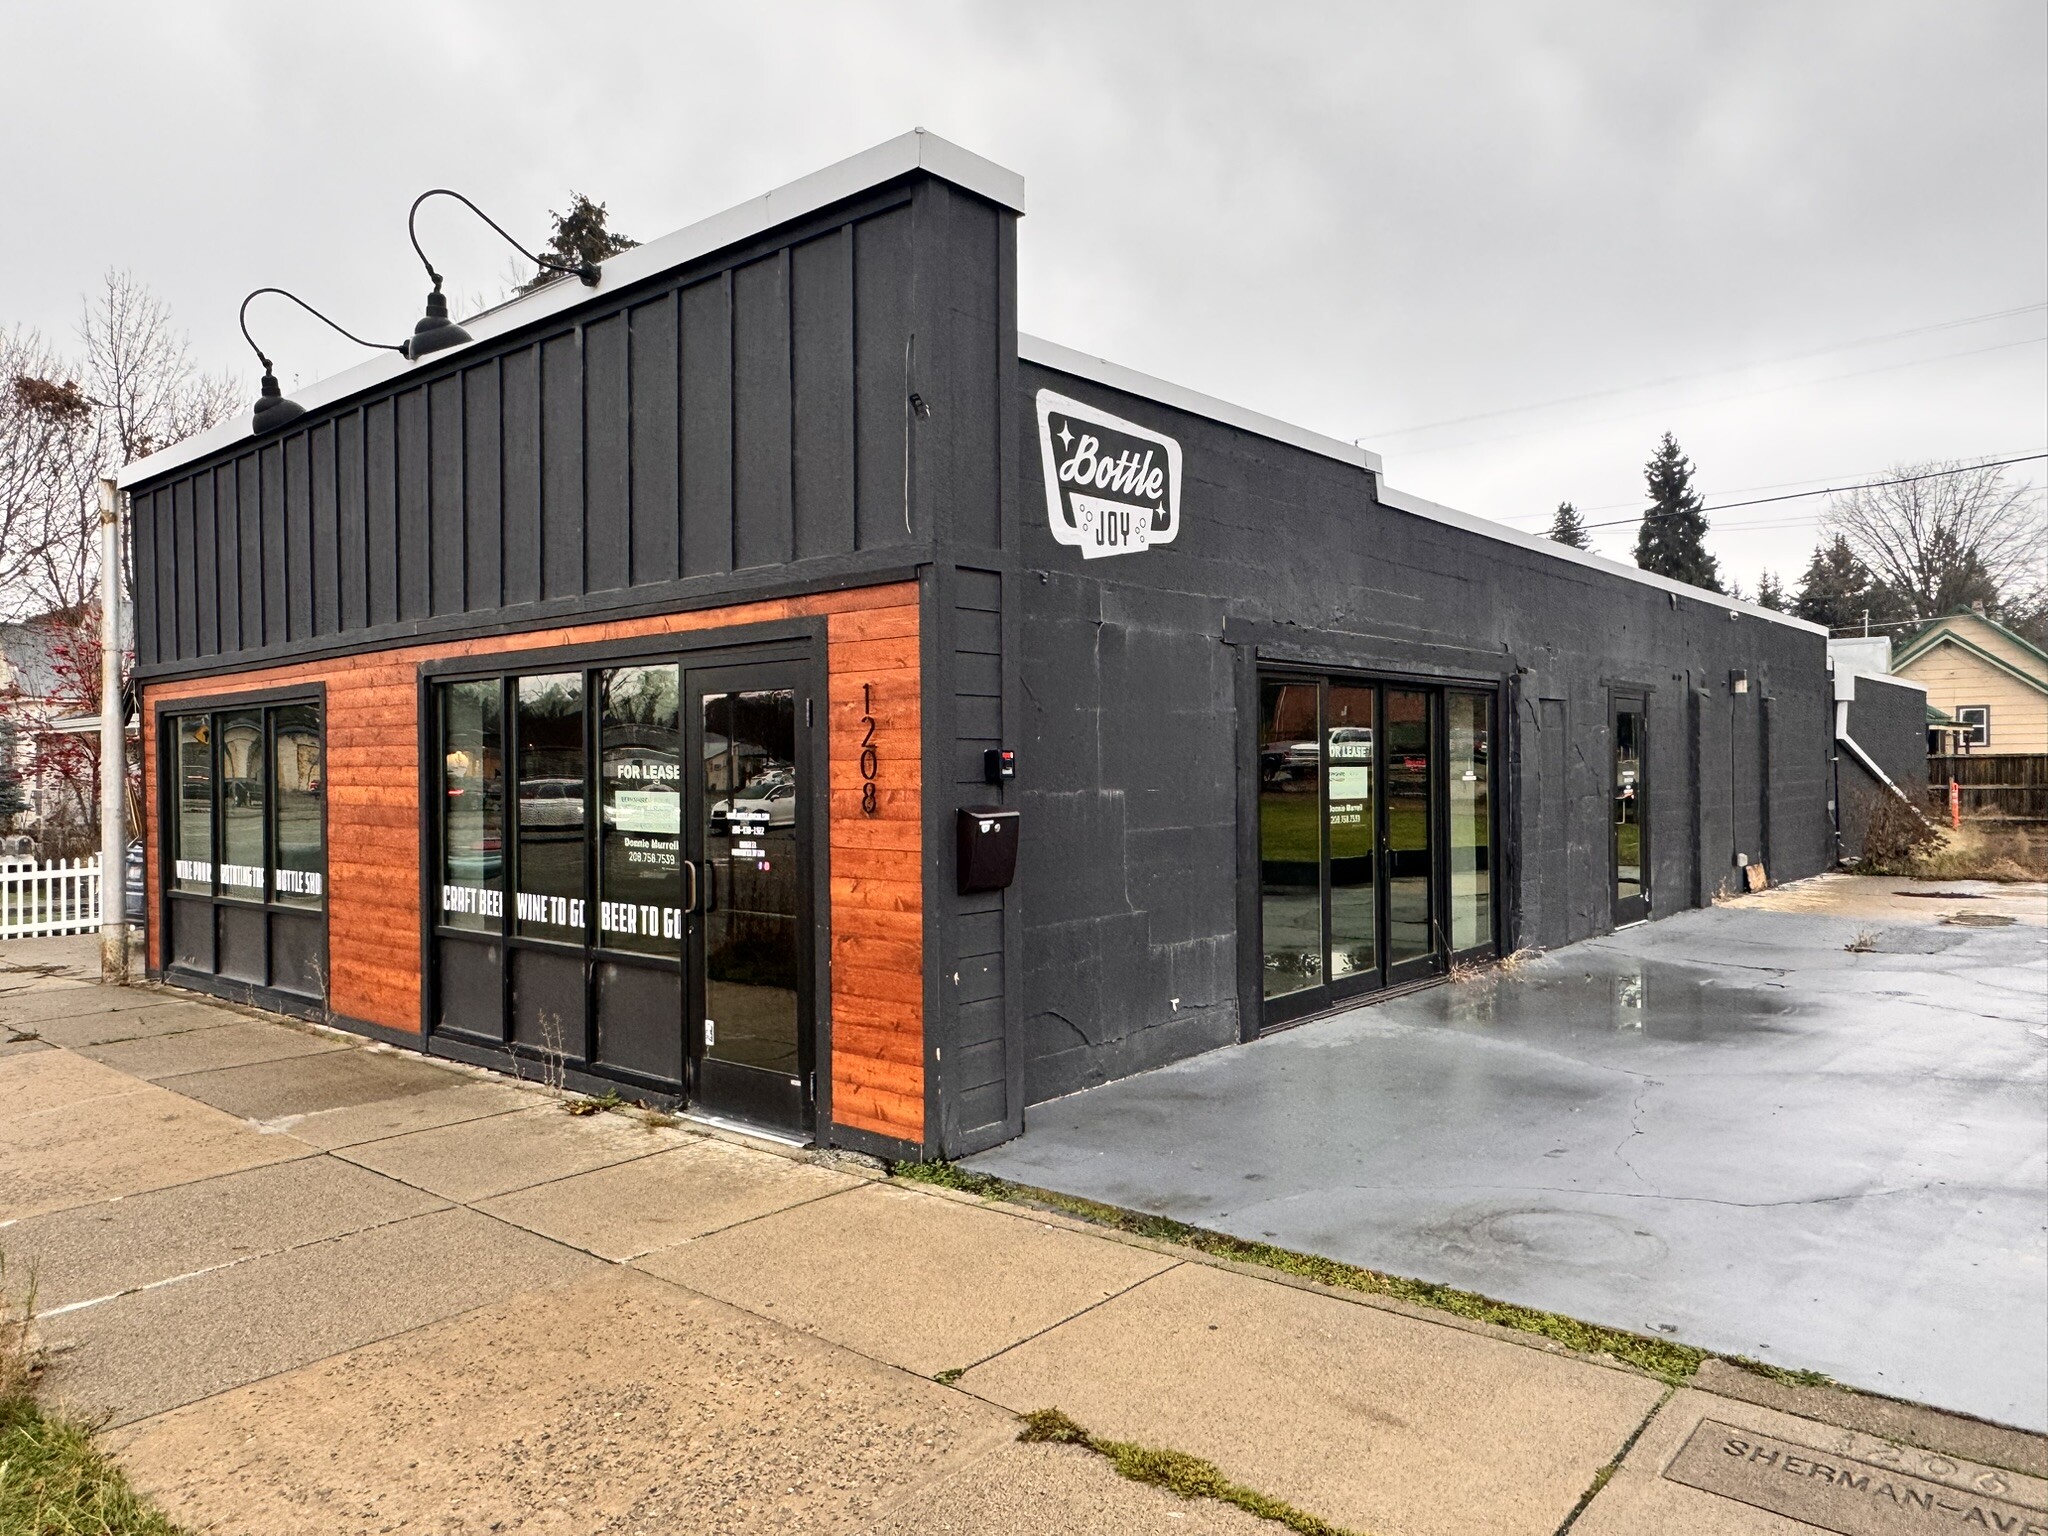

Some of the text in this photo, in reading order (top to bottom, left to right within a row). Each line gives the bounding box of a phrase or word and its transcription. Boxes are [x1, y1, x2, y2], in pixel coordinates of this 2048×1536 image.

[1059, 434, 1163, 499] Bottle
[1096, 511, 1130, 546] JOY
[861, 683, 878, 814] 1208
[1329, 745, 1367, 758] OR LEASE
[617, 764, 680, 780] FOR LEASE
[624, 837, 680, 851] Donnie Murrell
[628, 851, 676, 865] 208.758.7539
[276, 869, 322, 895] BOTTLE SHO
[443, 884, 477, 914] CRAFT
[516, 892, 548, 923] WINE
[550, 896, 567, 926] TO
[601, 901, 682, 940] BEER TO GO
